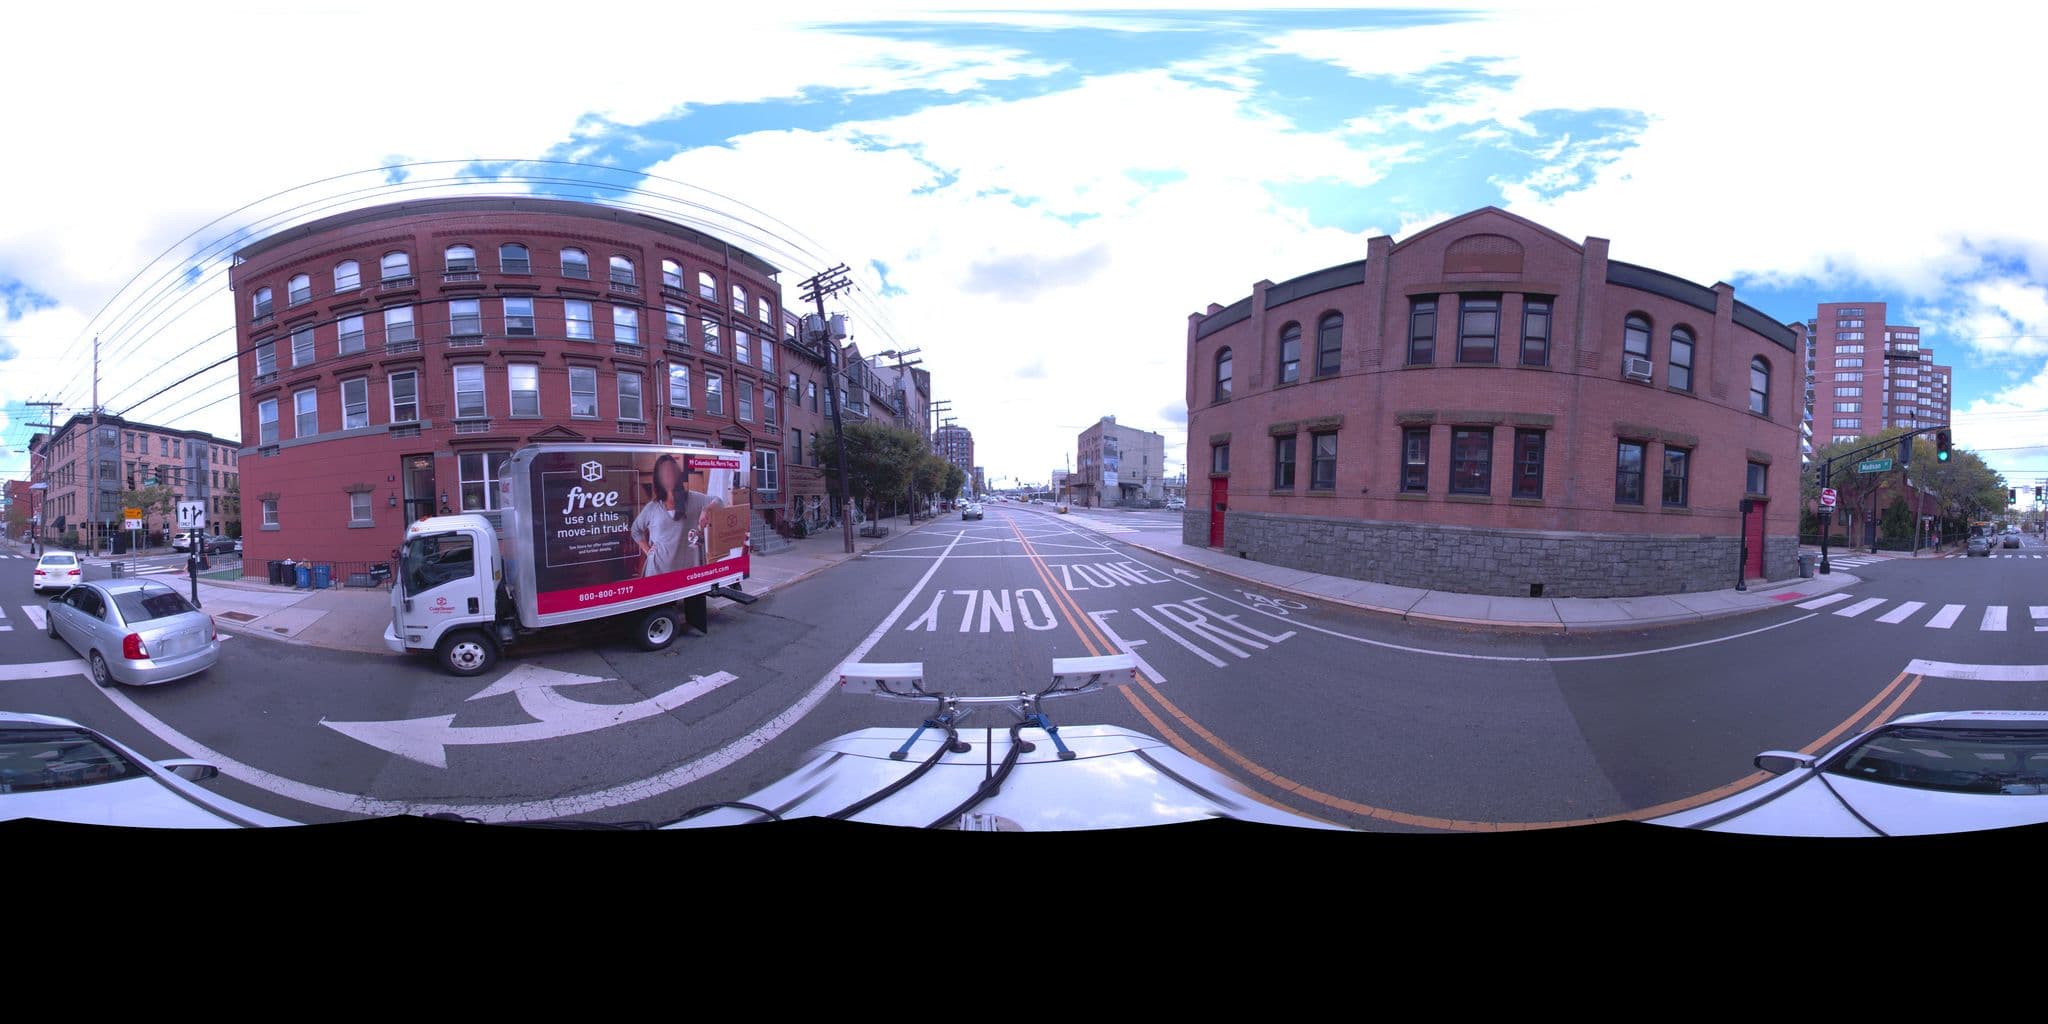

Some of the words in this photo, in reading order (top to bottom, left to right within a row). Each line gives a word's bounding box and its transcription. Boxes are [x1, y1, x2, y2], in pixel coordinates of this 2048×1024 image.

[562, 486, 619, 515] free
[564, 515, 584, 525] use
[587, 512, 597, 523] of
[600, 511, 619, 522] this
[557, 525, 600, 538] move-in
[603, 522, 629, 534] truck
[686, 565, 730, 581] cubesmart.com
[1048, 561, 1172, 591] ZONE
[579, 585, 634, 602] 800-800-1717
[904, 588, 1059, 633] ONLY
[1087, 597, 1297, 685] FIRE
